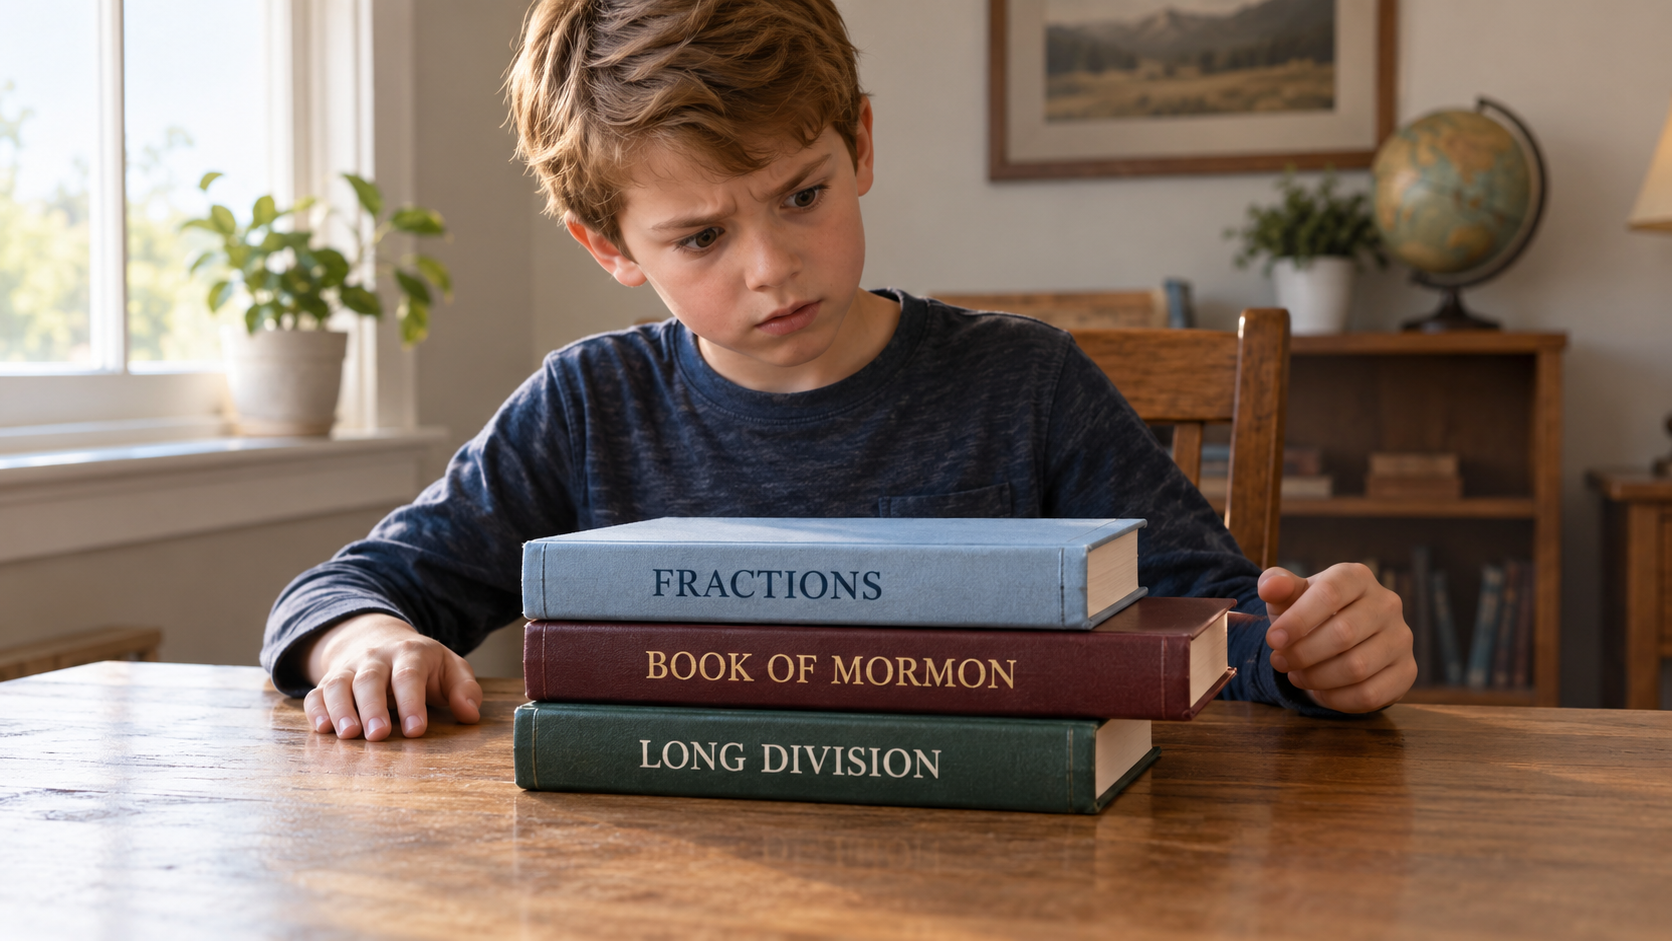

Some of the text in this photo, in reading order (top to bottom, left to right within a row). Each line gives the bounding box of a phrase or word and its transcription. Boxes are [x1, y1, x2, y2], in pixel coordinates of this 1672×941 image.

[652, 568, 883, 601] FRACTIONS
[645, 650, 1017, 690] BOOK OF MORMON
[639, 739, 942, 779] LONG DIVISION
